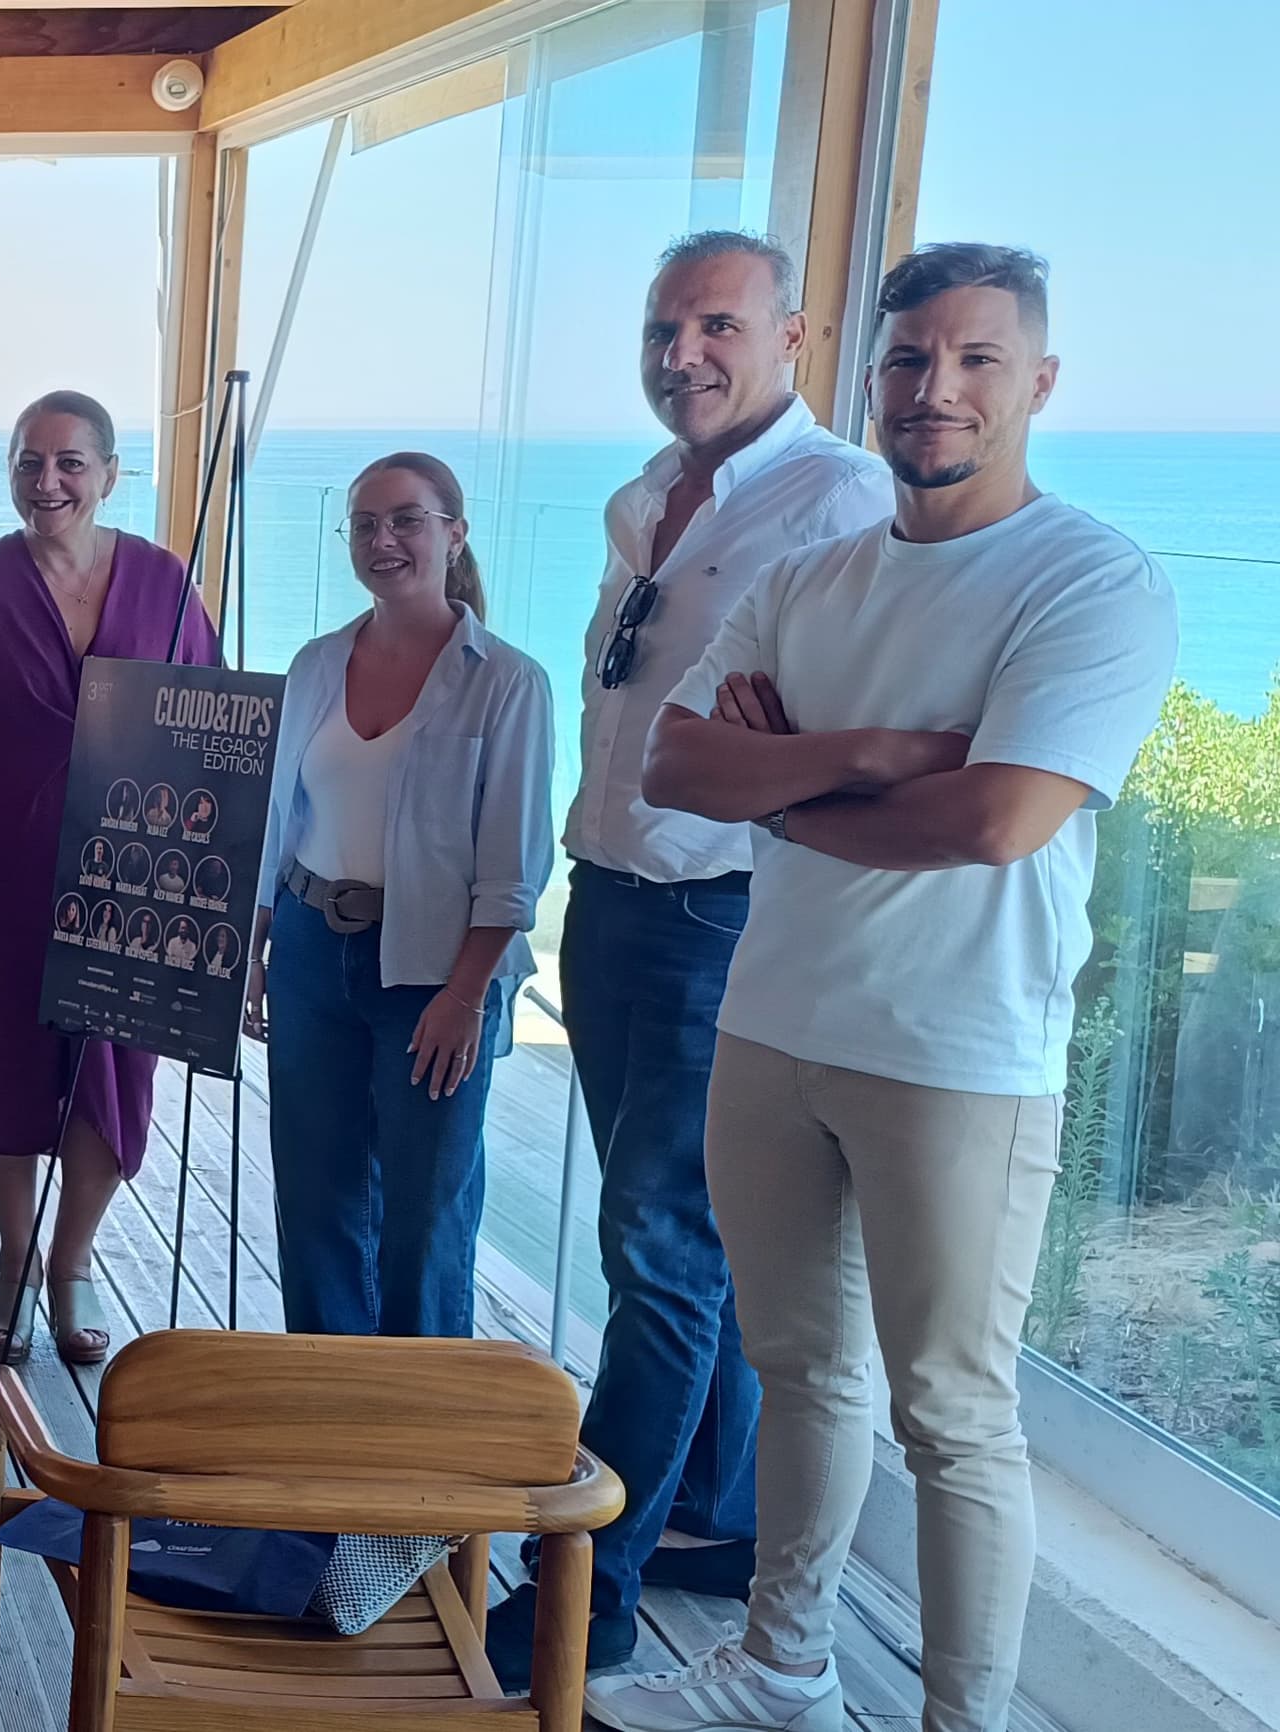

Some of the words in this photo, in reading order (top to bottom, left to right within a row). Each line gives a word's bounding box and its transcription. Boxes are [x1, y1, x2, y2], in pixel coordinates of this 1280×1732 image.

[154, 686, 274, 738] CLOUD&TIPS
[171, 730, 200, 750] THE
[202, 736, 268, 758] LEGACY
[203, 752, 264, 776] EDITION
